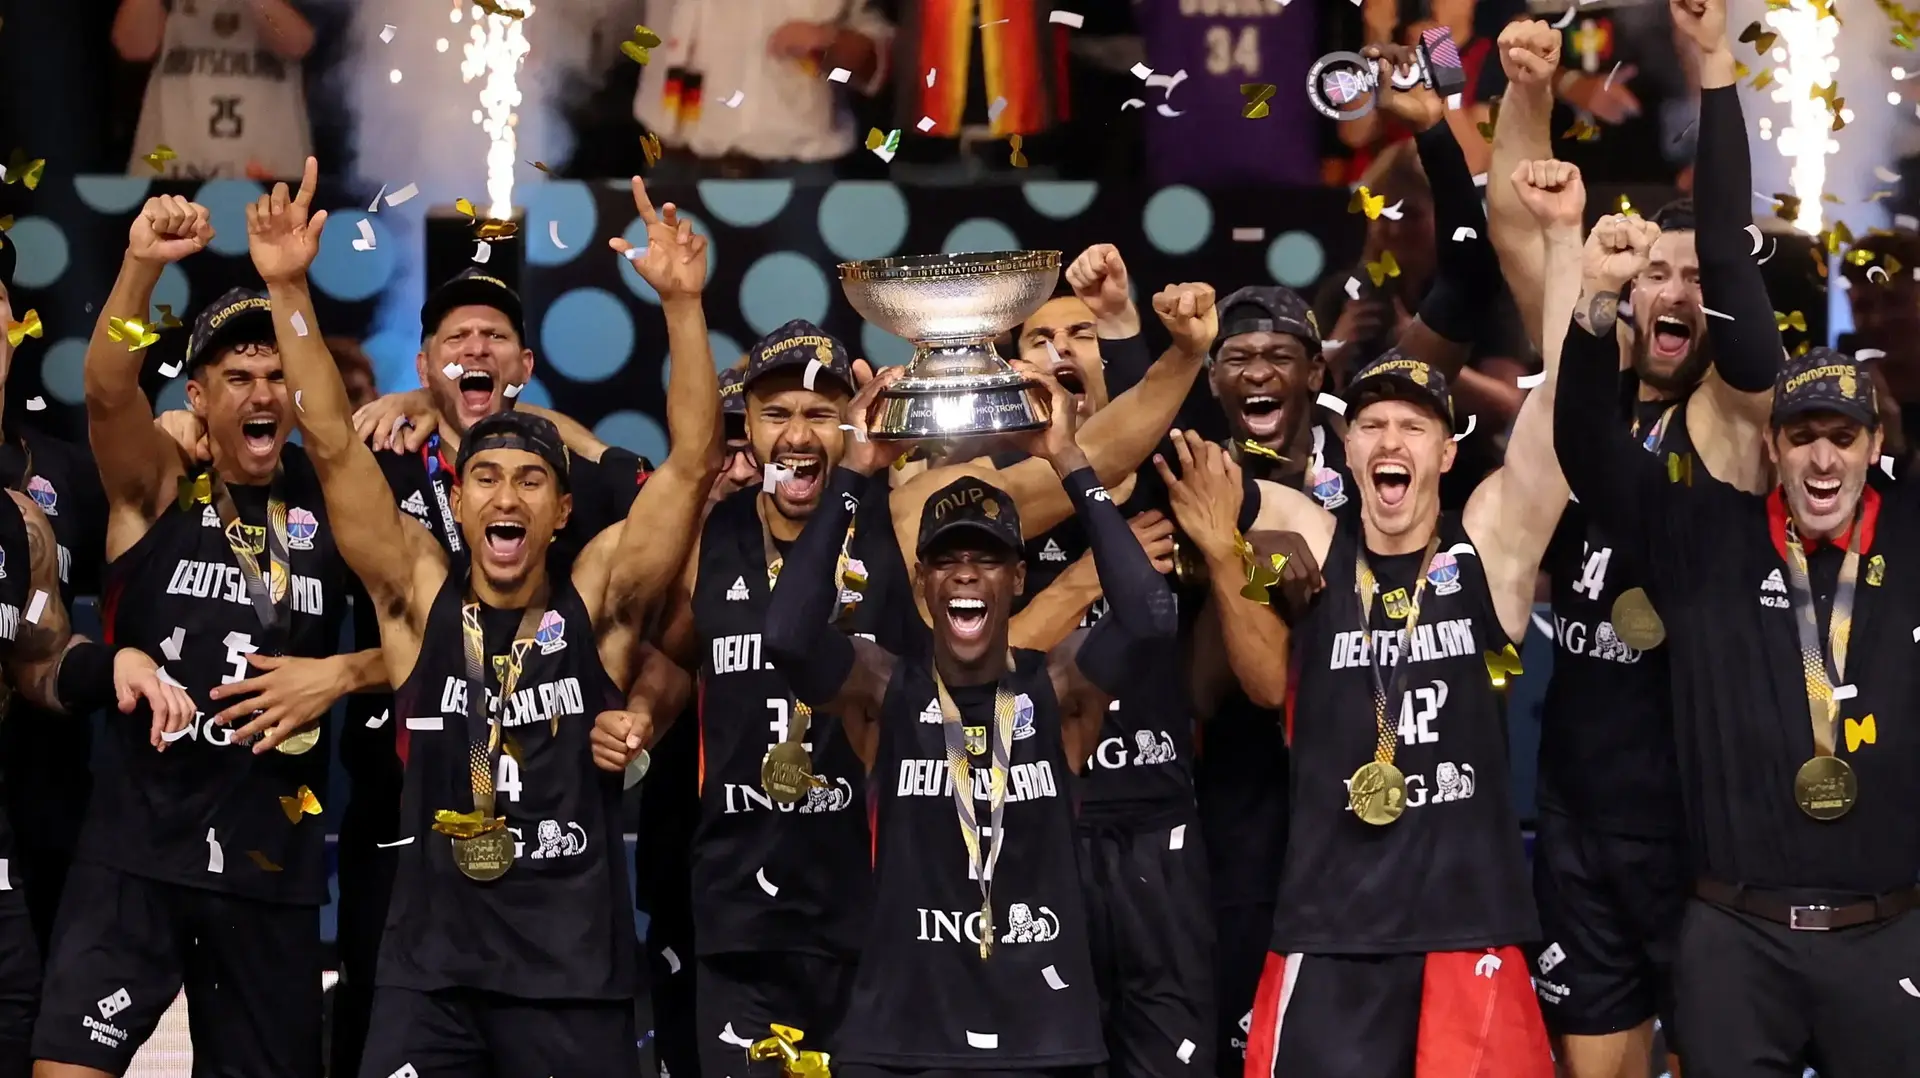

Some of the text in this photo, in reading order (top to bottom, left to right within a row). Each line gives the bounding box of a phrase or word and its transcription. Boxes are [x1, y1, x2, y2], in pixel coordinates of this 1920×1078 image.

[1205, 26, 1260, 75] 34
[209, 96, 243, 139] 25
[761, 335, 832, 361] CHAMPIONS
[1786, 364, 1856, 393] CHAMPIONS
[995, 403, 1024, 414] TROPHY
[400, 499, 430, 517] PEAK
[432, 479, 461, 553] #EUROBASKET
[935, 487, 984, 520] MVP
[1038, 551, 1068, 562] PEAK
[1397, 687, 1439, 745] 42
[496, 754, 523, 802] 4
[82, 1015, 129, 1041] Domino's
[89, 1029, 120, 1049] Pizza
